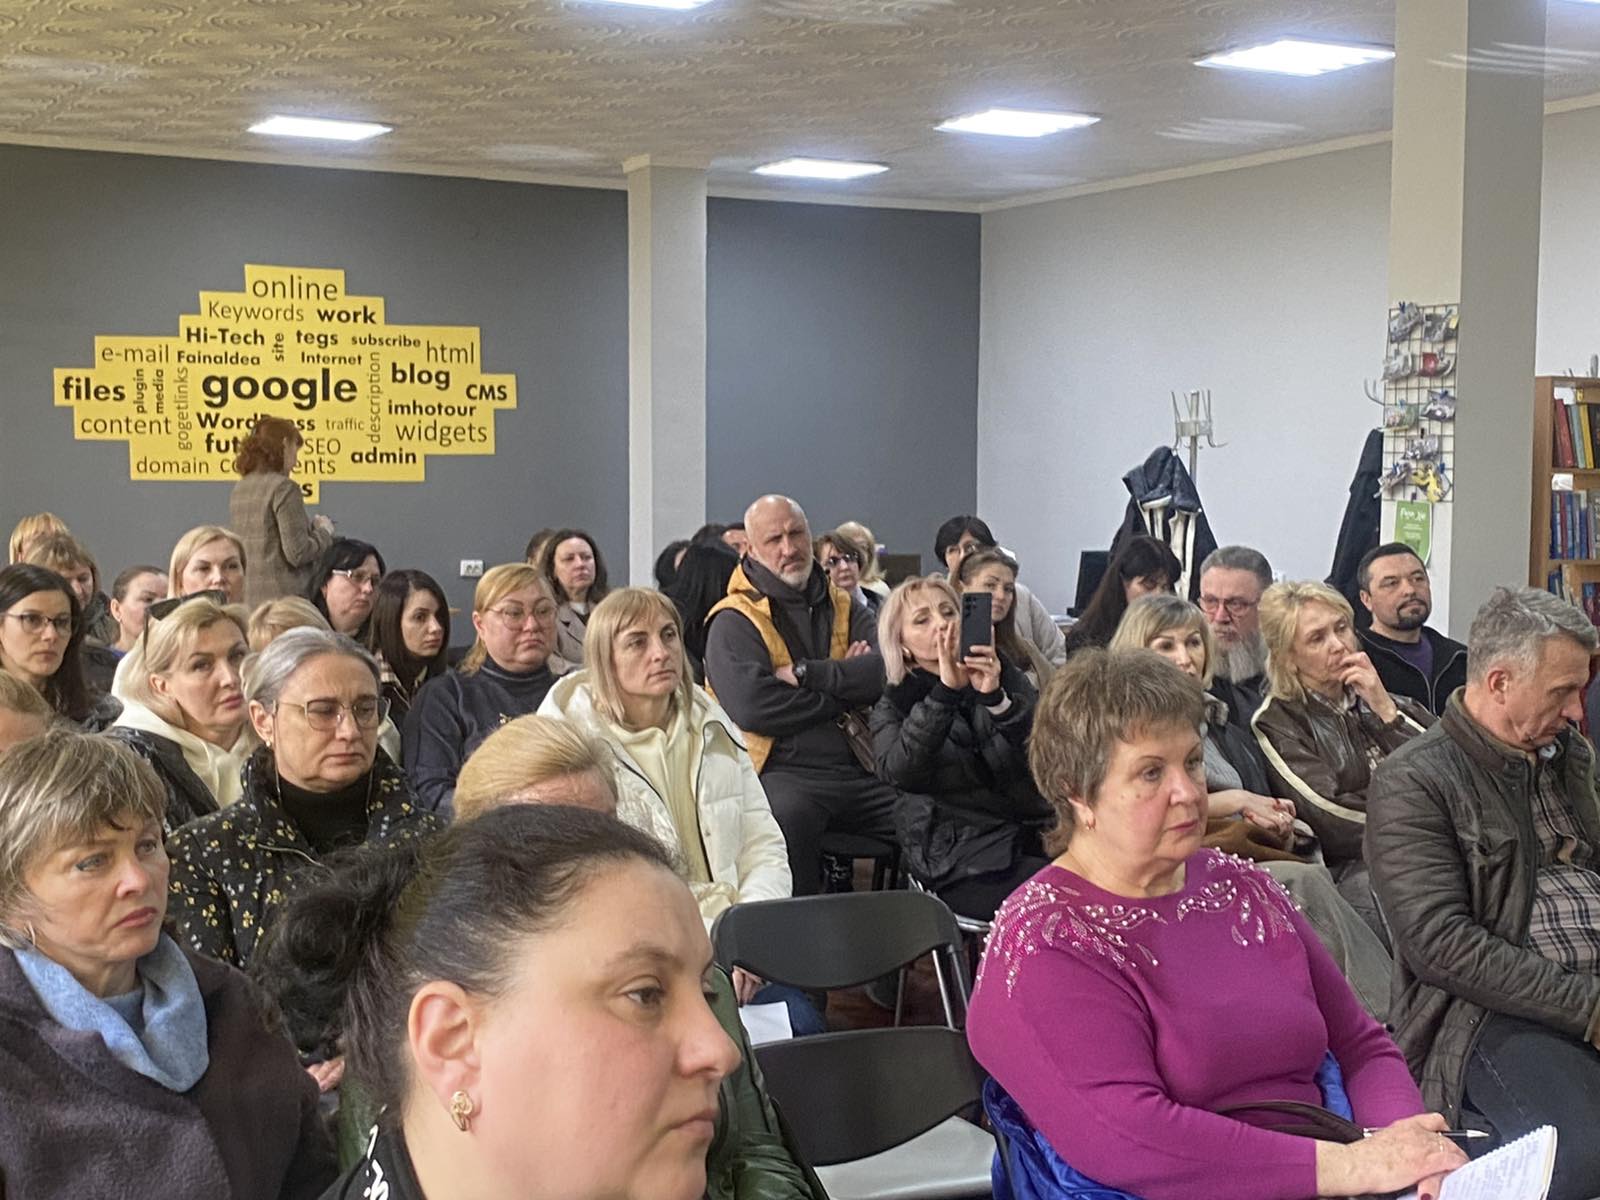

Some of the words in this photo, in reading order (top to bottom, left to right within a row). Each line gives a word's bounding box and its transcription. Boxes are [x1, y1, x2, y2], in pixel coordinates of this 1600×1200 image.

[252, 274, 338, 301] online
[208, 300, 304, 323] Keywords
[317, 305, 376, 324] work
[187, 327, 264, 345] Hi-Tech
[296, 330, 338, 349] tegs
[352, 334, 420, 347] subscribe
[102, 344, 168, 363] e-mail
[272, 333, 284, 361] site
[427, 340, 474, 364] html
[301, 351, 362, 366] Internet
[391, 362, 451, 391] blog
[63, 376, 125, 401] files
[133, 369, 147, 414] plugin
[154, 368, 165, 414] media
[202, 368, 357, 411] google
[366, 352, 383, 443] description
[466, 384, 507, 401] CMS
[174, 367, 192, 450] gogetlinks
[388, 400, 477, 416] imhotour
[81, 416, 171, 435] content
[196, 411, 316, 432] Wordss
[326, 418, 364, 430] traffic
[395, 419, 488, 446] widgets
[303, 438, 341, 455] SEO
[350, 447, 417, 465] admin
[137, 456, 209, 474] domain
